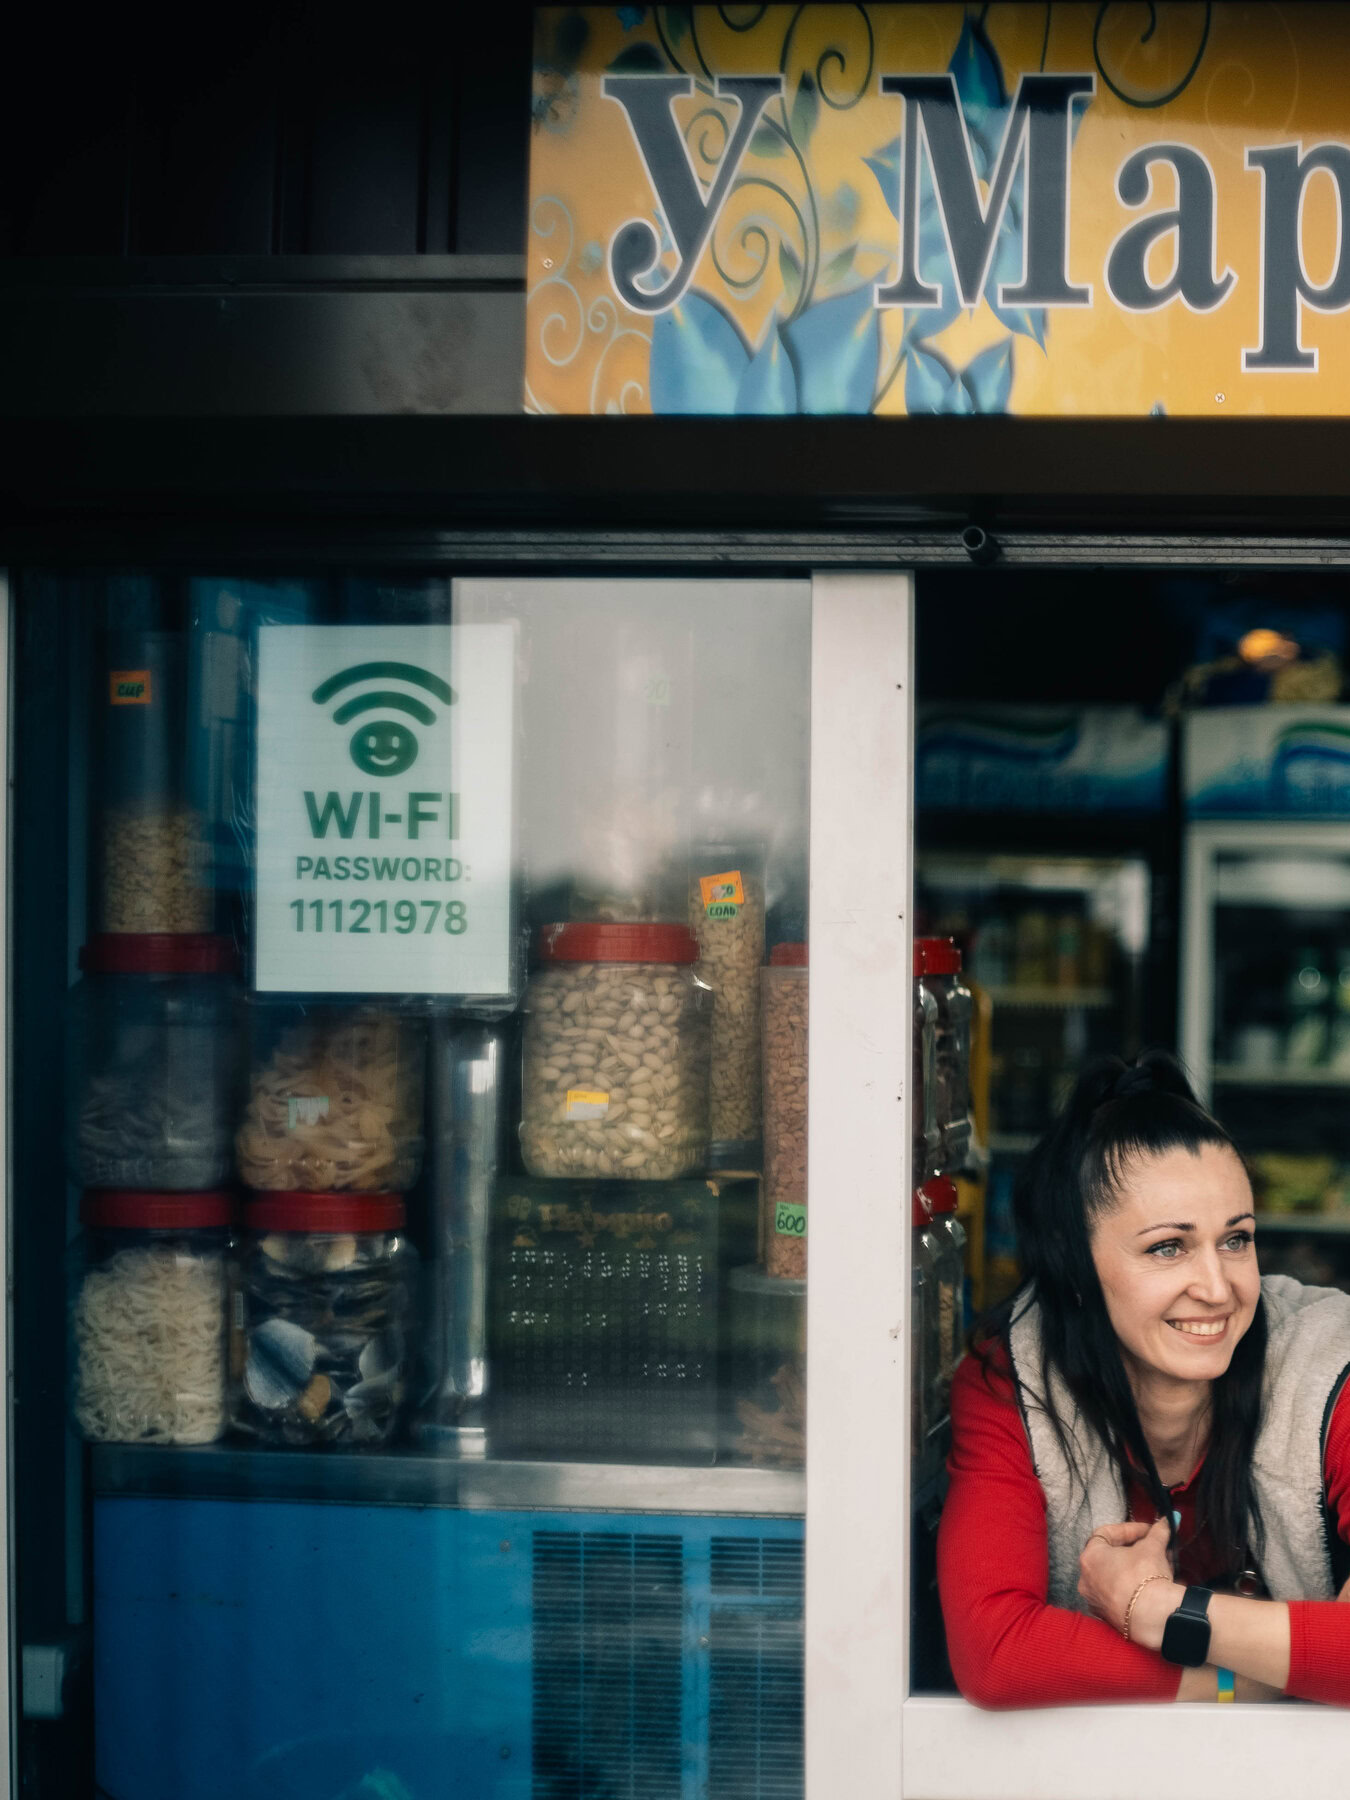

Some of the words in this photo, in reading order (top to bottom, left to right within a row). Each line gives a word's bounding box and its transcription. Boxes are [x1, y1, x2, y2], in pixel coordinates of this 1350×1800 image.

[602, 72, 784, 313] У
[303, 791, 460, 840] WI-FI
[296, 856, 472, 882] PASSWORD:
[289, 898, 468, 935] 11121978
[777, 1211, 806, 1233] 600
